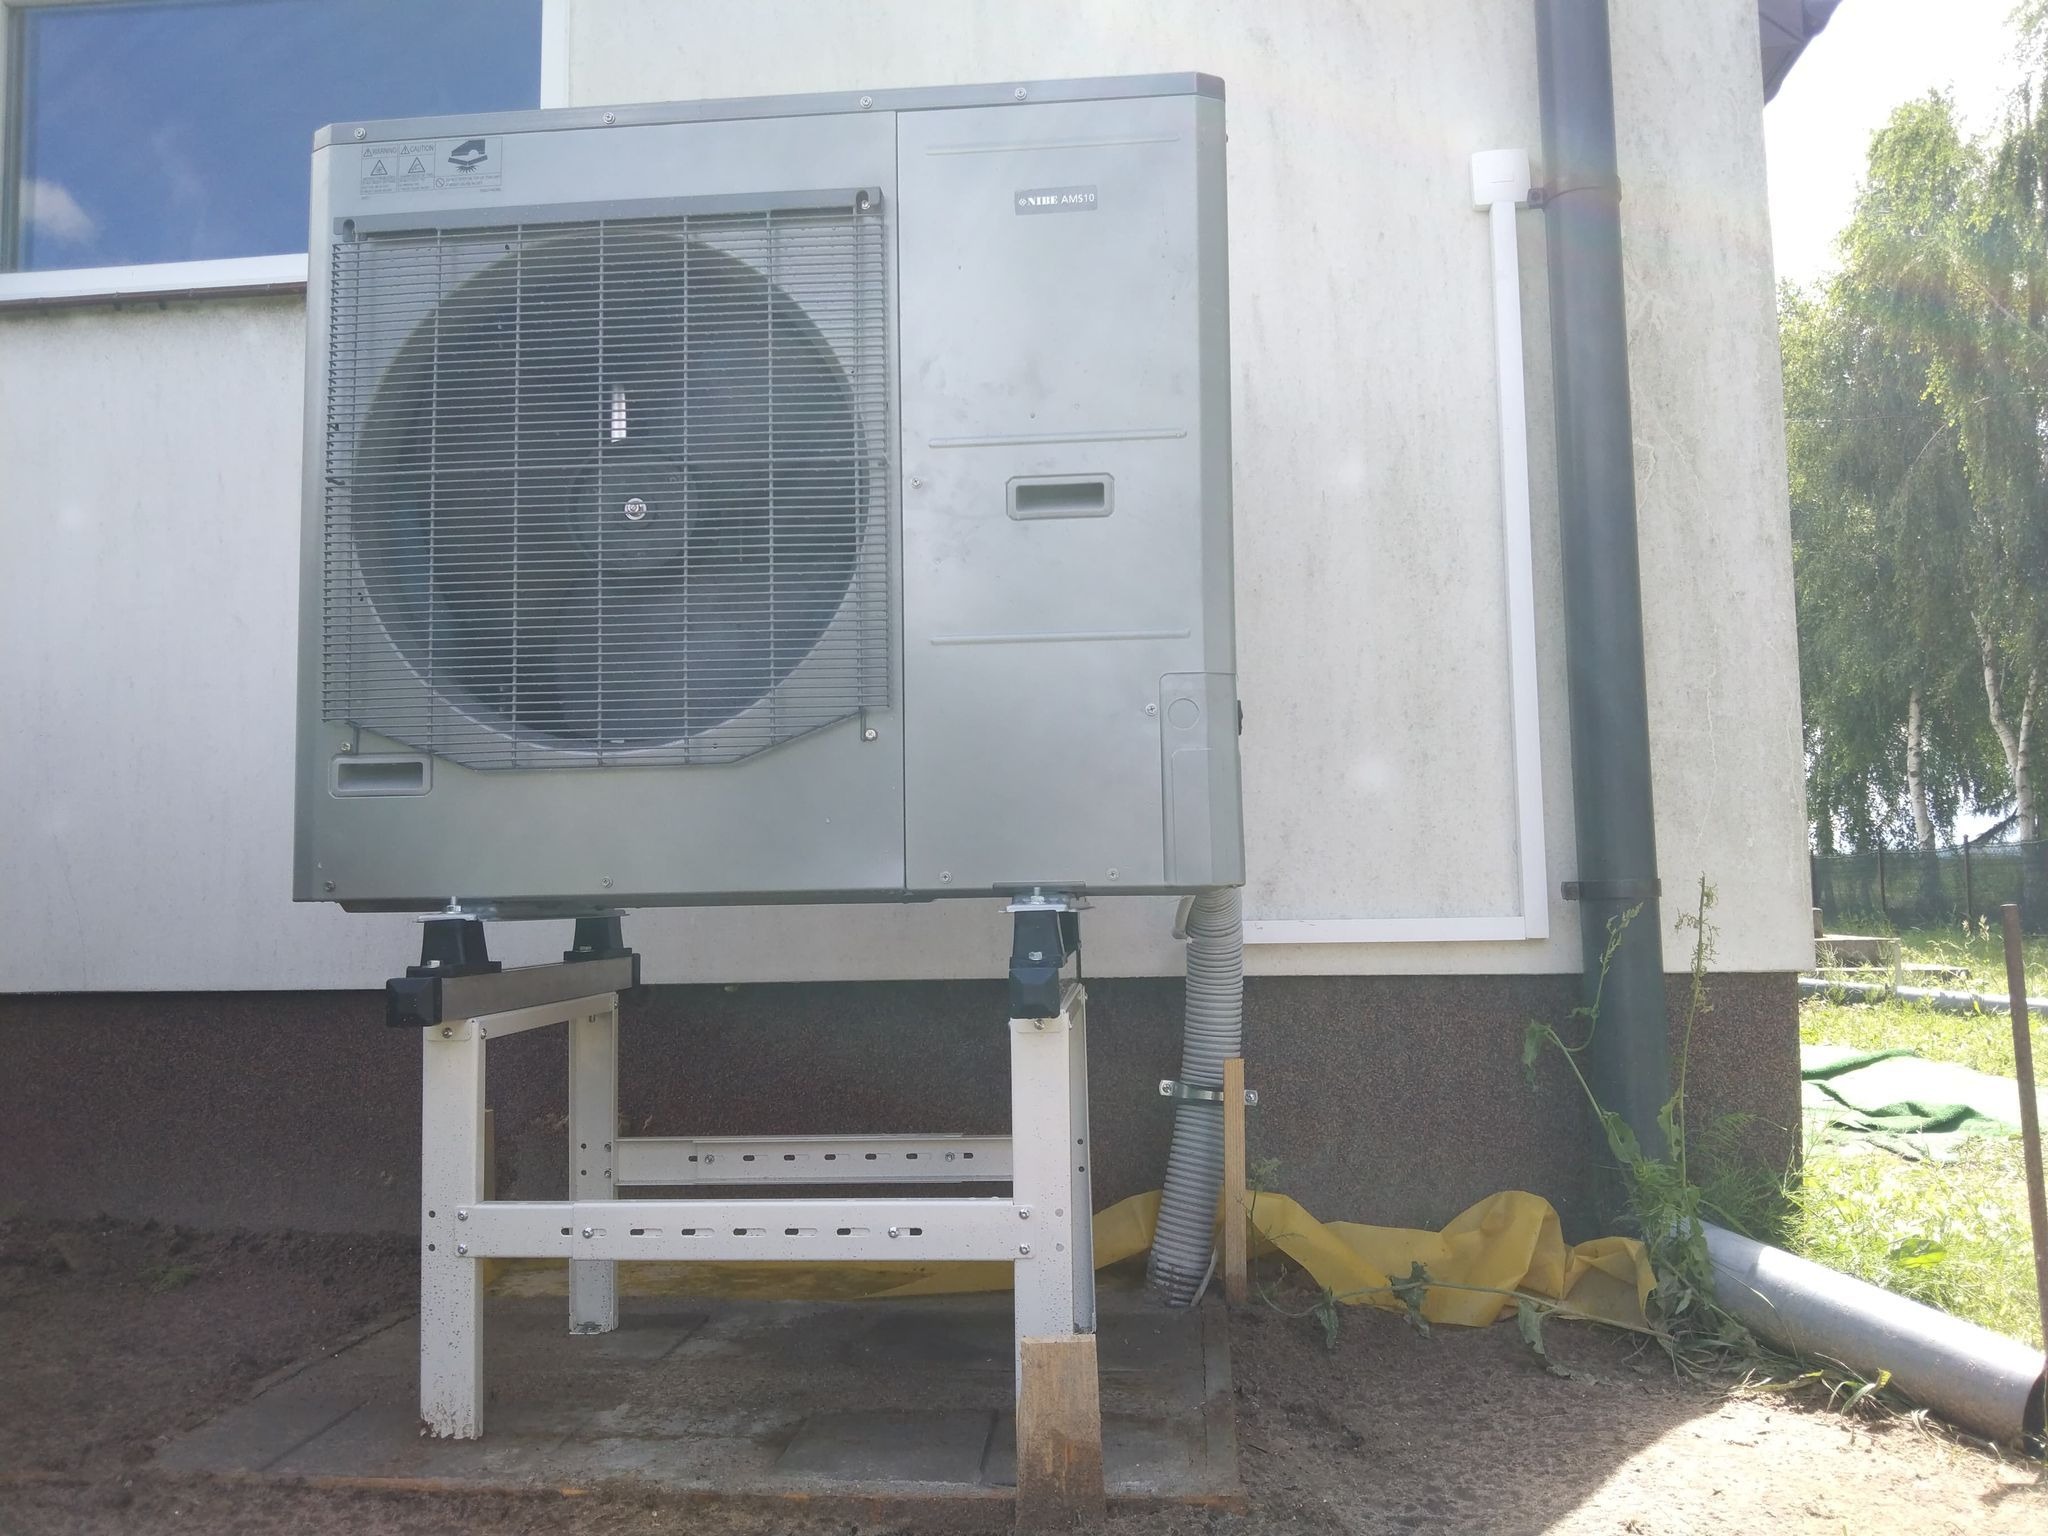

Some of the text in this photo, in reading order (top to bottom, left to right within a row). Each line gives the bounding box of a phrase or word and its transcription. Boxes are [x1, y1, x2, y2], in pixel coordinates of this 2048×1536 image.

[372, 146, 397, 155] WARNING
[409, 144, 434, 153] CAUTION
[1027, 193, 1095, 206] NIBE AMS10
